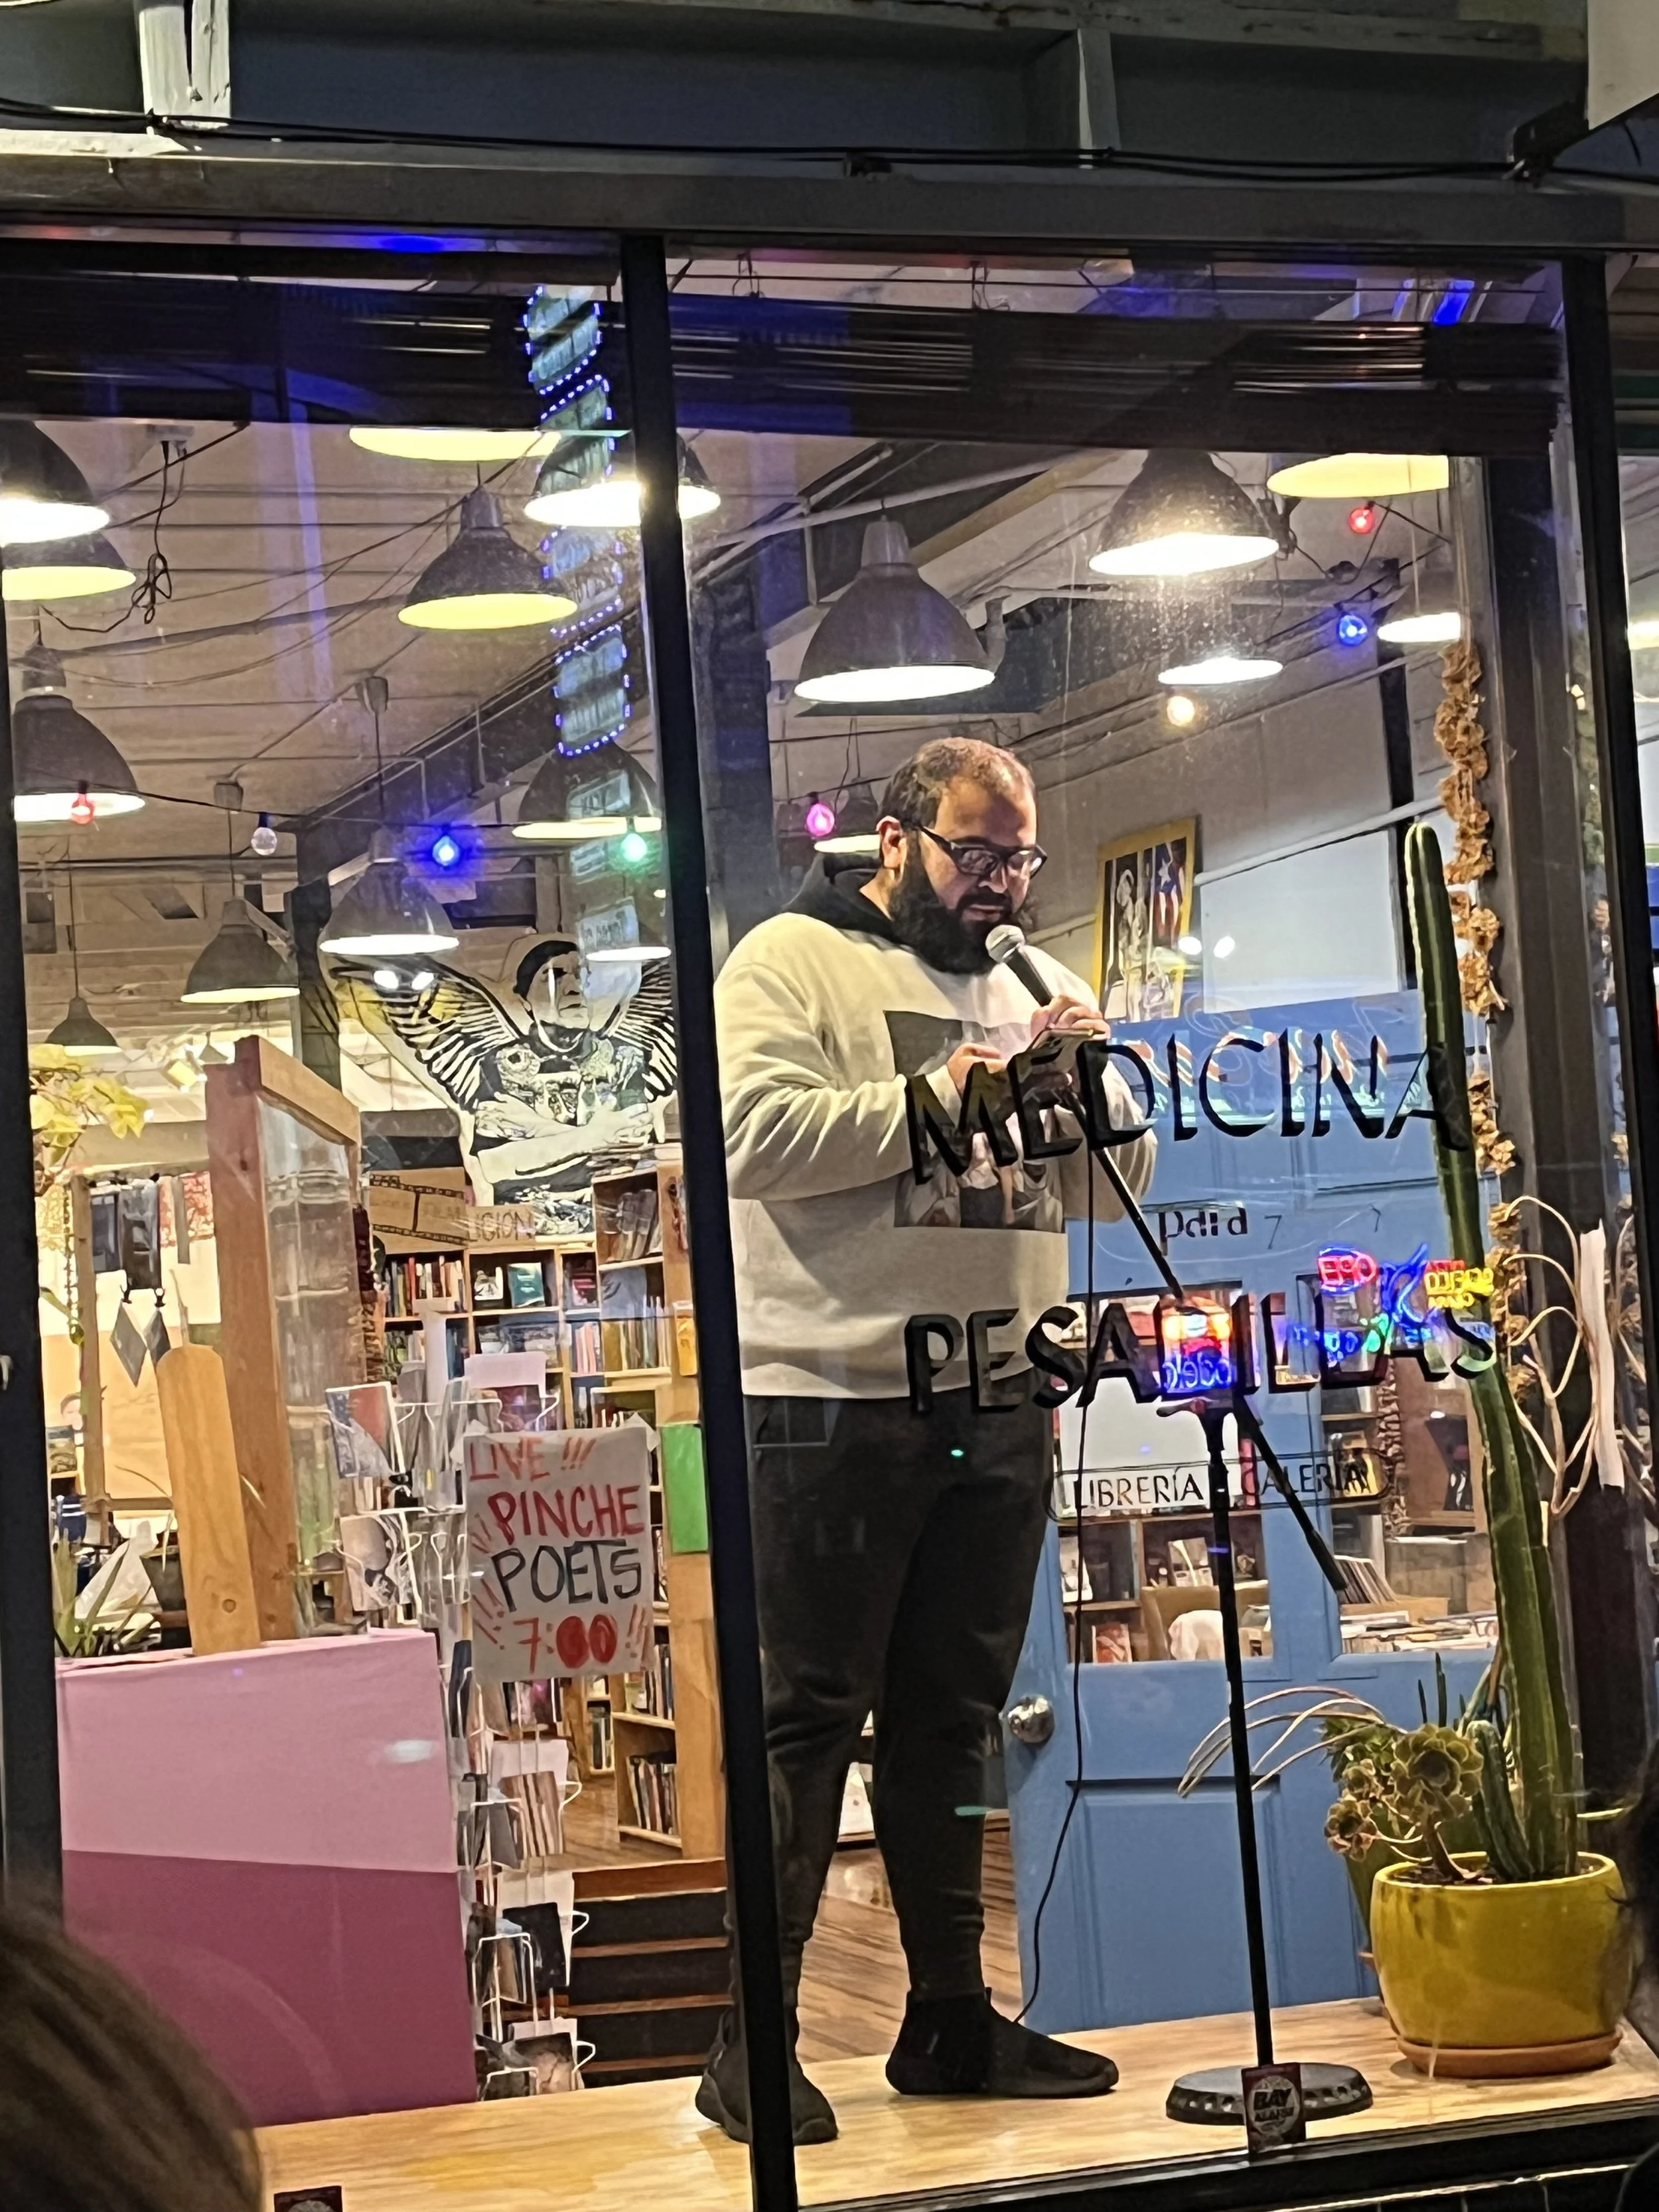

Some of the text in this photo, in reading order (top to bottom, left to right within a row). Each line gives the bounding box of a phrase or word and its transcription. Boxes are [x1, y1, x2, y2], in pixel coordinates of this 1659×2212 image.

[904, 1027, 1469, 1185] MEDICINA
[468, 1436, 551, 1482] LIVE
[486, 1483, 646, 1546] PINCHE
[491, 1538, 642, 1613] POETS
[513, 1613, 618, 1674] 7:00
